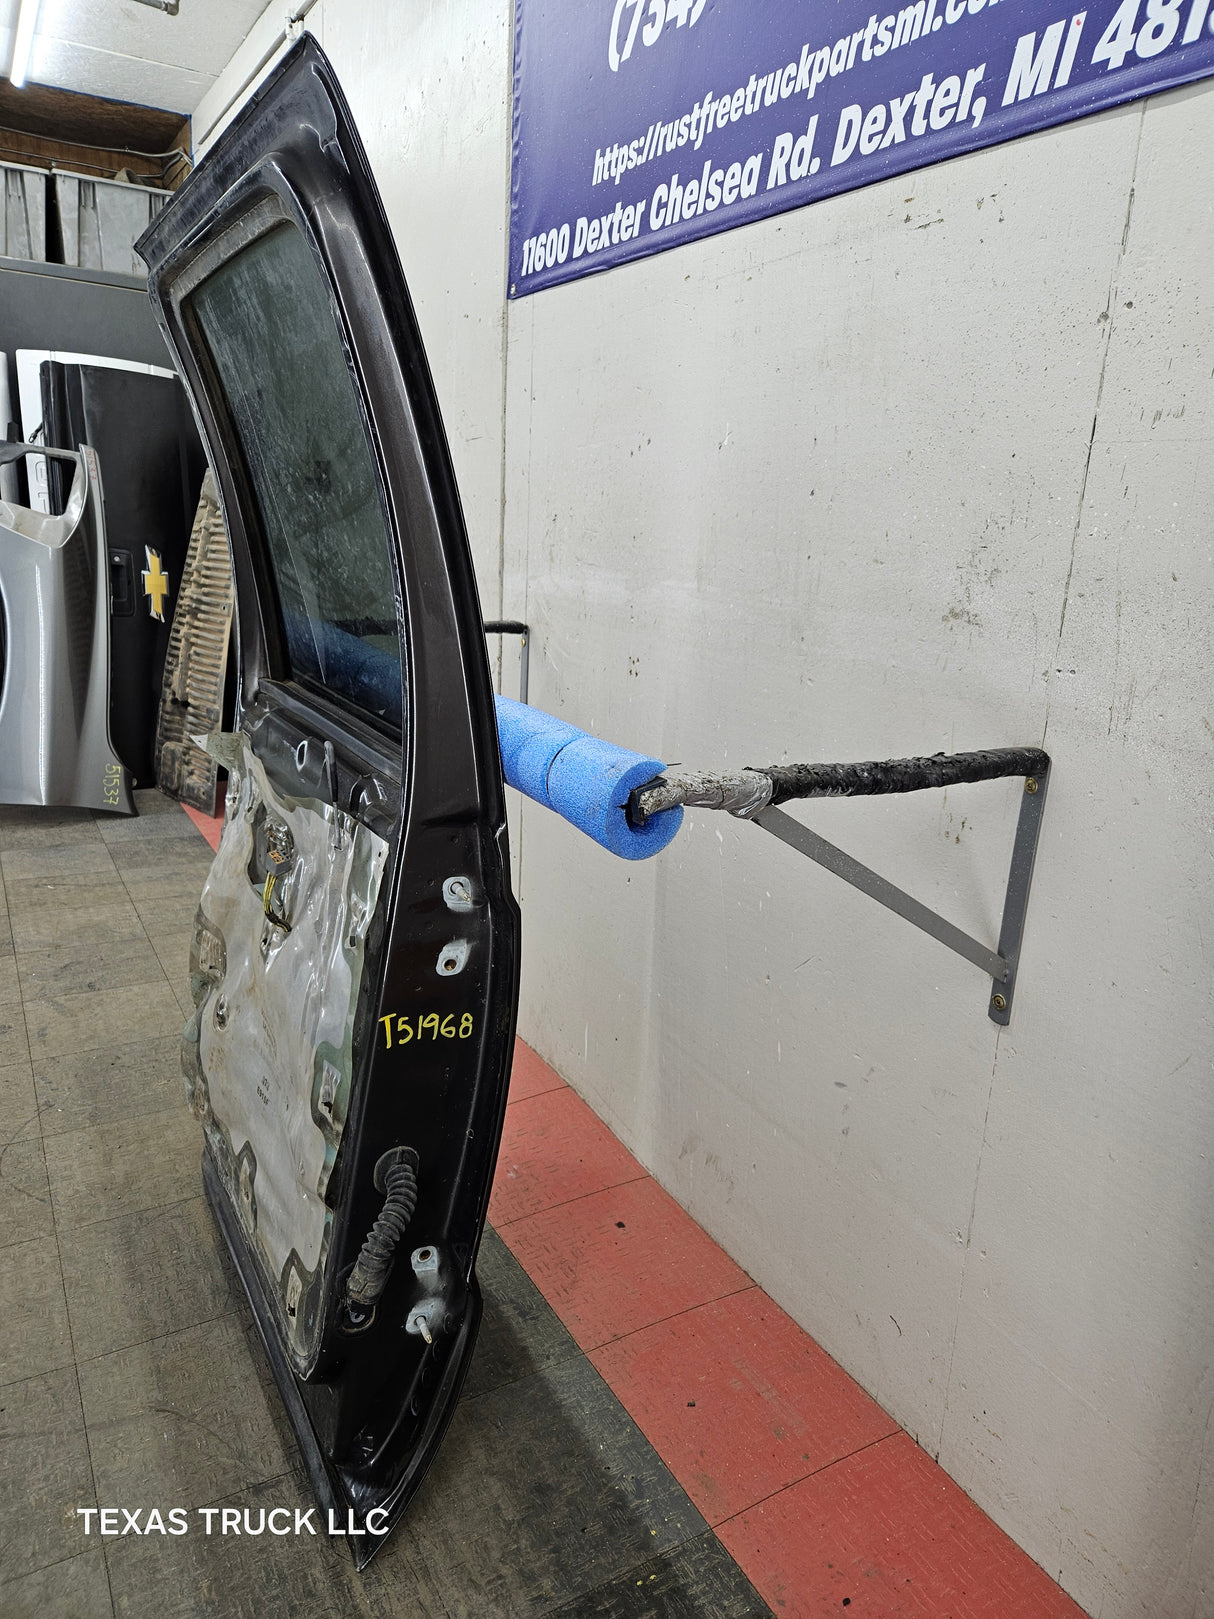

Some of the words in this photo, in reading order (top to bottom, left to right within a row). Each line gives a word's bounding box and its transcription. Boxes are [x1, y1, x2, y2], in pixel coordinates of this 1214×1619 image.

[521, 223, 570, 276] 11600
[573, 199, 646, 258] Dexter
[650, 153, 762, 231] Chelsea
[767, 114, 821, 191] Rd.
[831, 63, 987, 168] Dexter,
[1002, 11, 1088, 107] MI
[1091, 0, 1214, 71] 481
[103, 763, 121, 805] 51537
[378, 1013, 473, 1049] T51968
